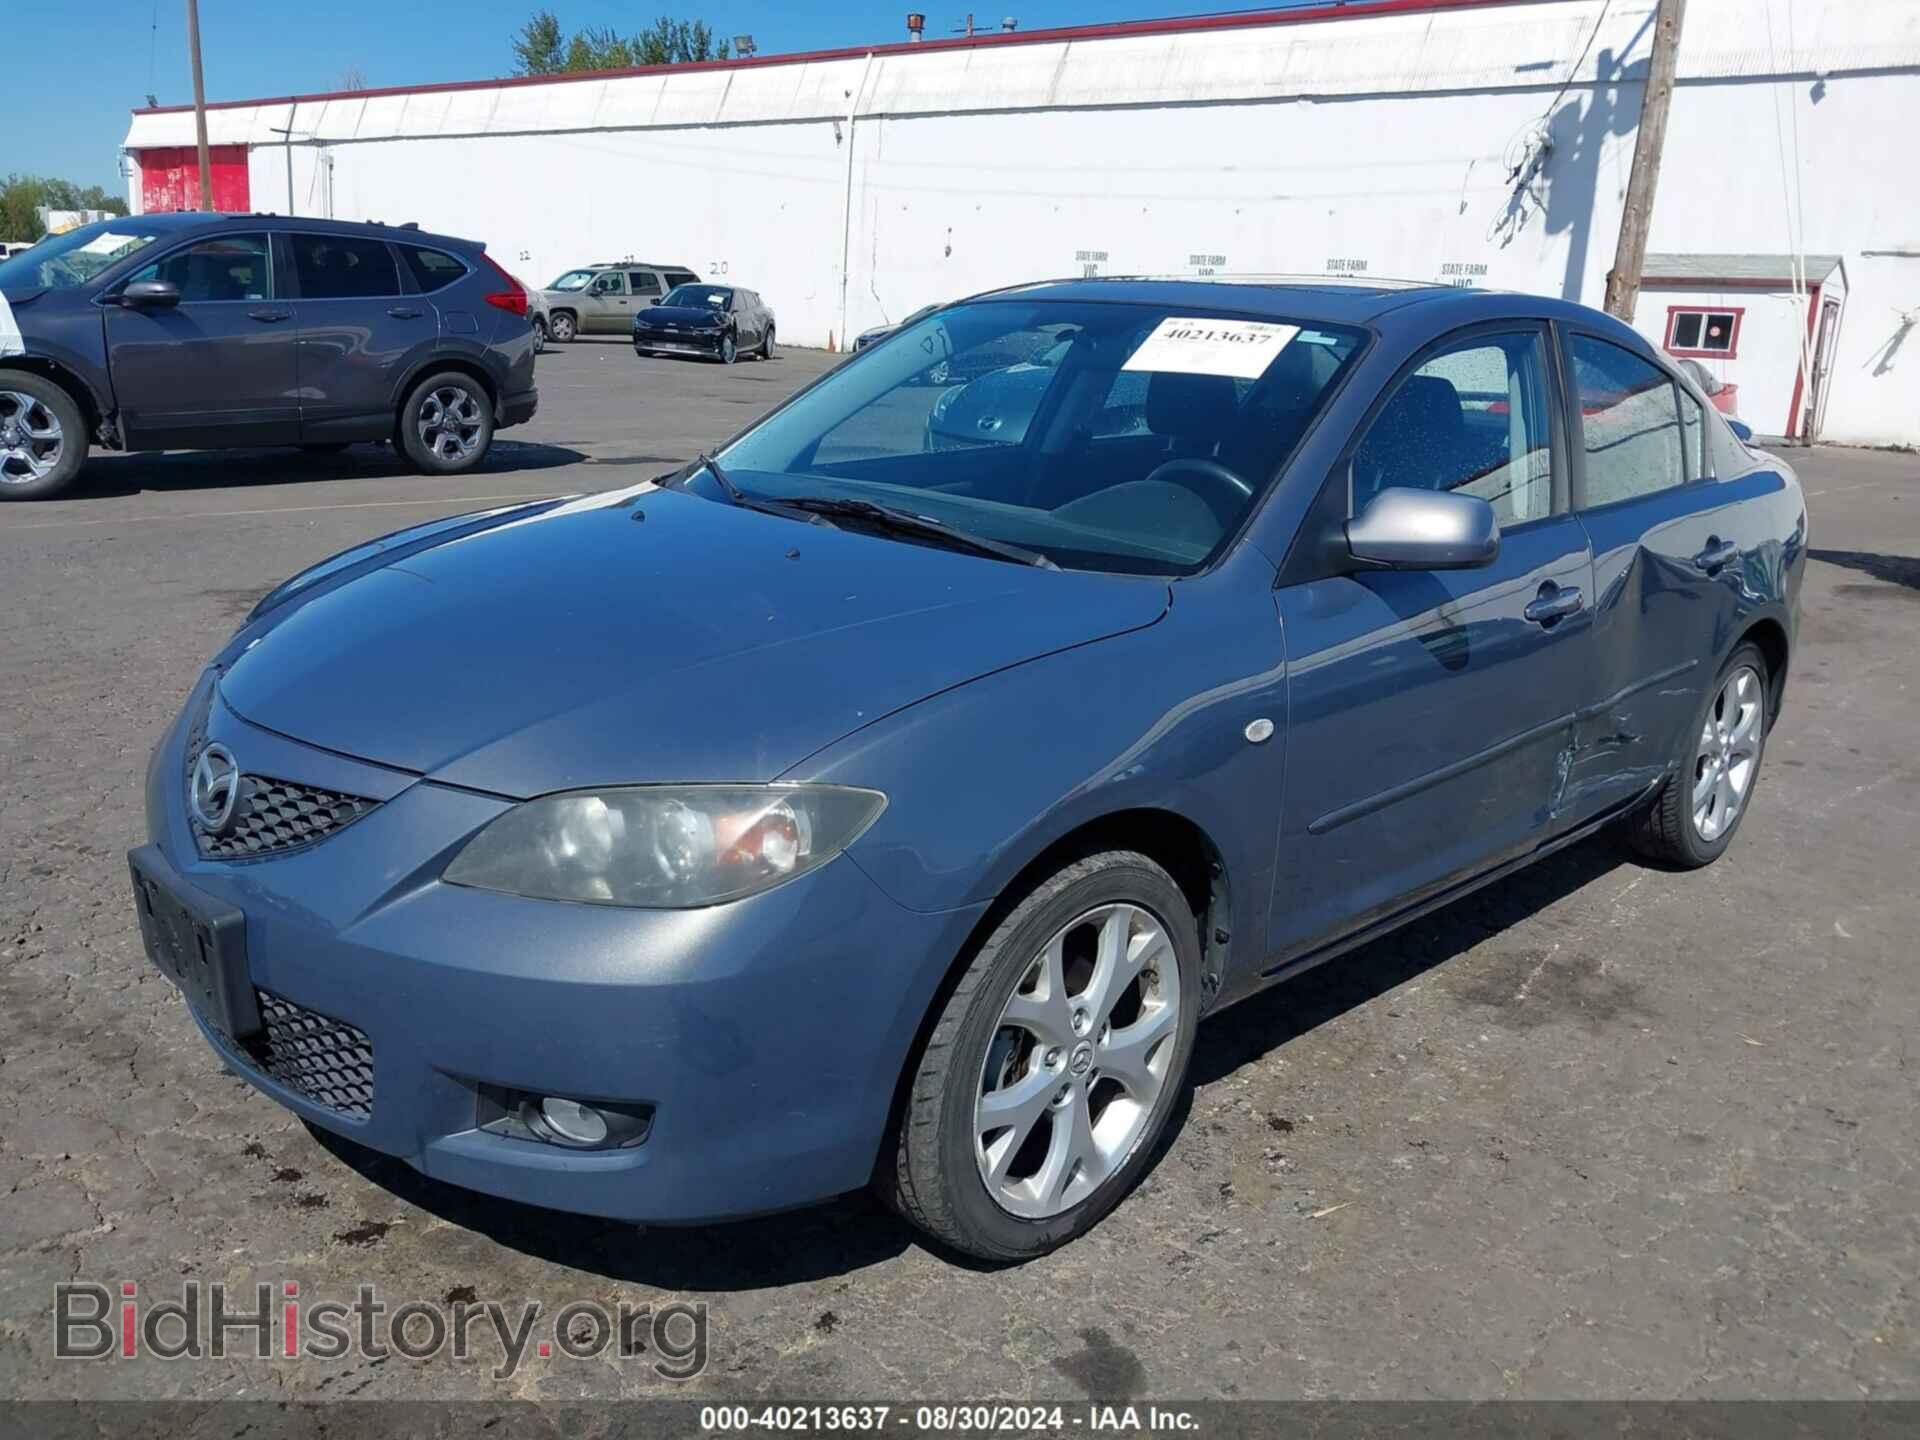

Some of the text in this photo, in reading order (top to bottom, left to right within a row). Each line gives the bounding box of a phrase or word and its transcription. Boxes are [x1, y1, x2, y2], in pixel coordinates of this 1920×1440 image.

[1075, 250, 1109, 262] STATE FARM
[1189, 254, 1227, 266] STATE FARM
[709, 260, 729, 275] 20
[1326, 258, 1368, 271] STATE FARM
[1441, 263, 1488, 276] STATE FARM
[1163, 328, 1273, 345] 40213637
